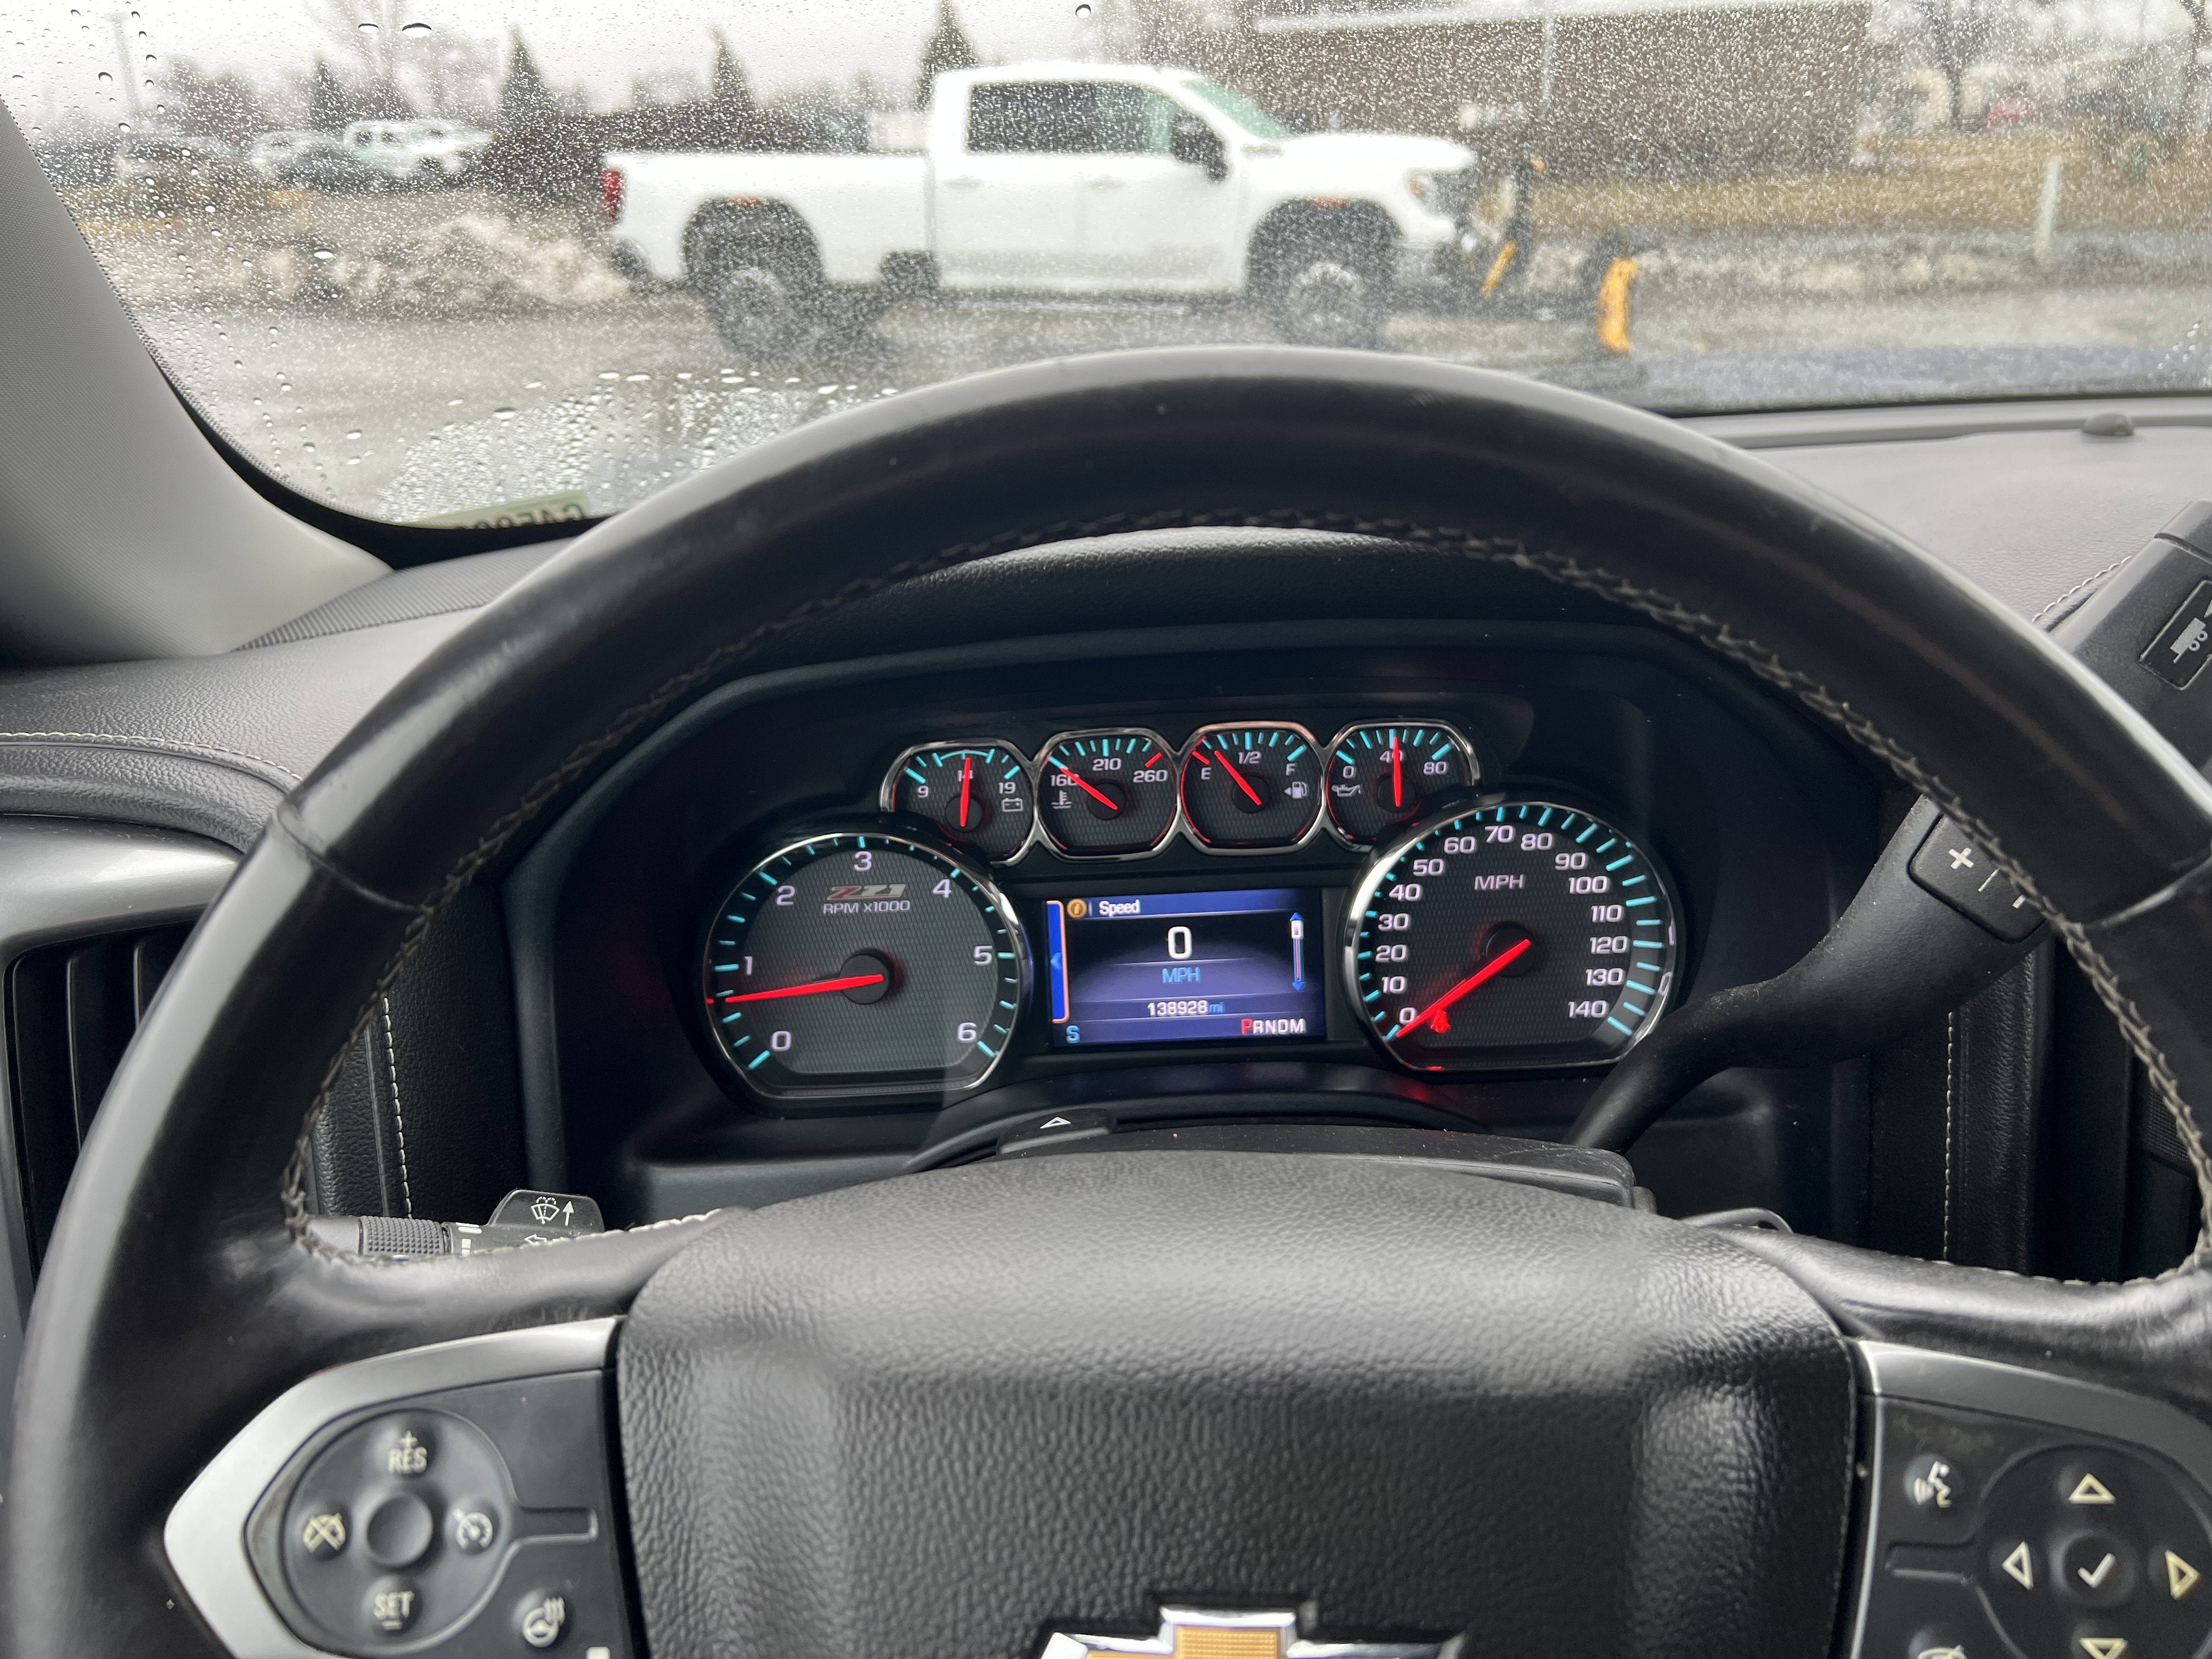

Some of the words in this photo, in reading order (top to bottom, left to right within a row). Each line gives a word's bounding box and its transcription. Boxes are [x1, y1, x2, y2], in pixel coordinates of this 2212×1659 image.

[1092, 758, 1121, 771] 210
[1238, 752, 1261, 764] 1/2
[1133, 770, 1167, 783] 260
[1200, 768, 1210, 780] E
[1285, 763, 1296, 776] F
[1342, 766, 1355, 779] 0
[1423, 761, 1447, 775] 80
[917, 785, 929, 798] 9
[998, 781, 1016, 794] 19
[1485, 825, 1515, 843] 70
[1521, 833, 1553, 851] 80
[1444, 837, 1476, 854] 60
[854, 851, 872, 871] 3
[1413, 859, 1444, 877] 50
[1555, 852, 1587, 871] 90
[933, 879, 951, 898] 4
[1474, 874, 1525, 890] MPH
[1568, 876, 1609, 895] 100
[776, 885, 795, 906] 2
[827, 883, 906, 900] Z71
[1389, 883, 1422, 901] 40
[823, 902, 859, 914] RPM
[1099, 899, 1141, 917] Speed
[1591, 905, 1622, 923] 110
[1378, 913, 1410, 931] 30
[1167, 926, 1192, 960] 0
[1590, 936, 1627, 955] 120
[973, 945, 992, 966] 5
[1375, 944, 1408, 963] 20
[743, 956, 753, 975] 1
[1162, 967, 1201, 983] MPH
[1585, 968, 1624, 986] 130
[1381, 976, 1407, 994] 10
[1399, 1007, 1417, 1024] 0
[1567, 998, 1607, 1018] 140
[957, 1022, 978, 1042] 6
[1066, 1025, 1081, 1043] S
[771, 1031, 791, 1052] 0
[388, 1447, 427, 1474] RES
[373, 1592, 415, 1618] SET
